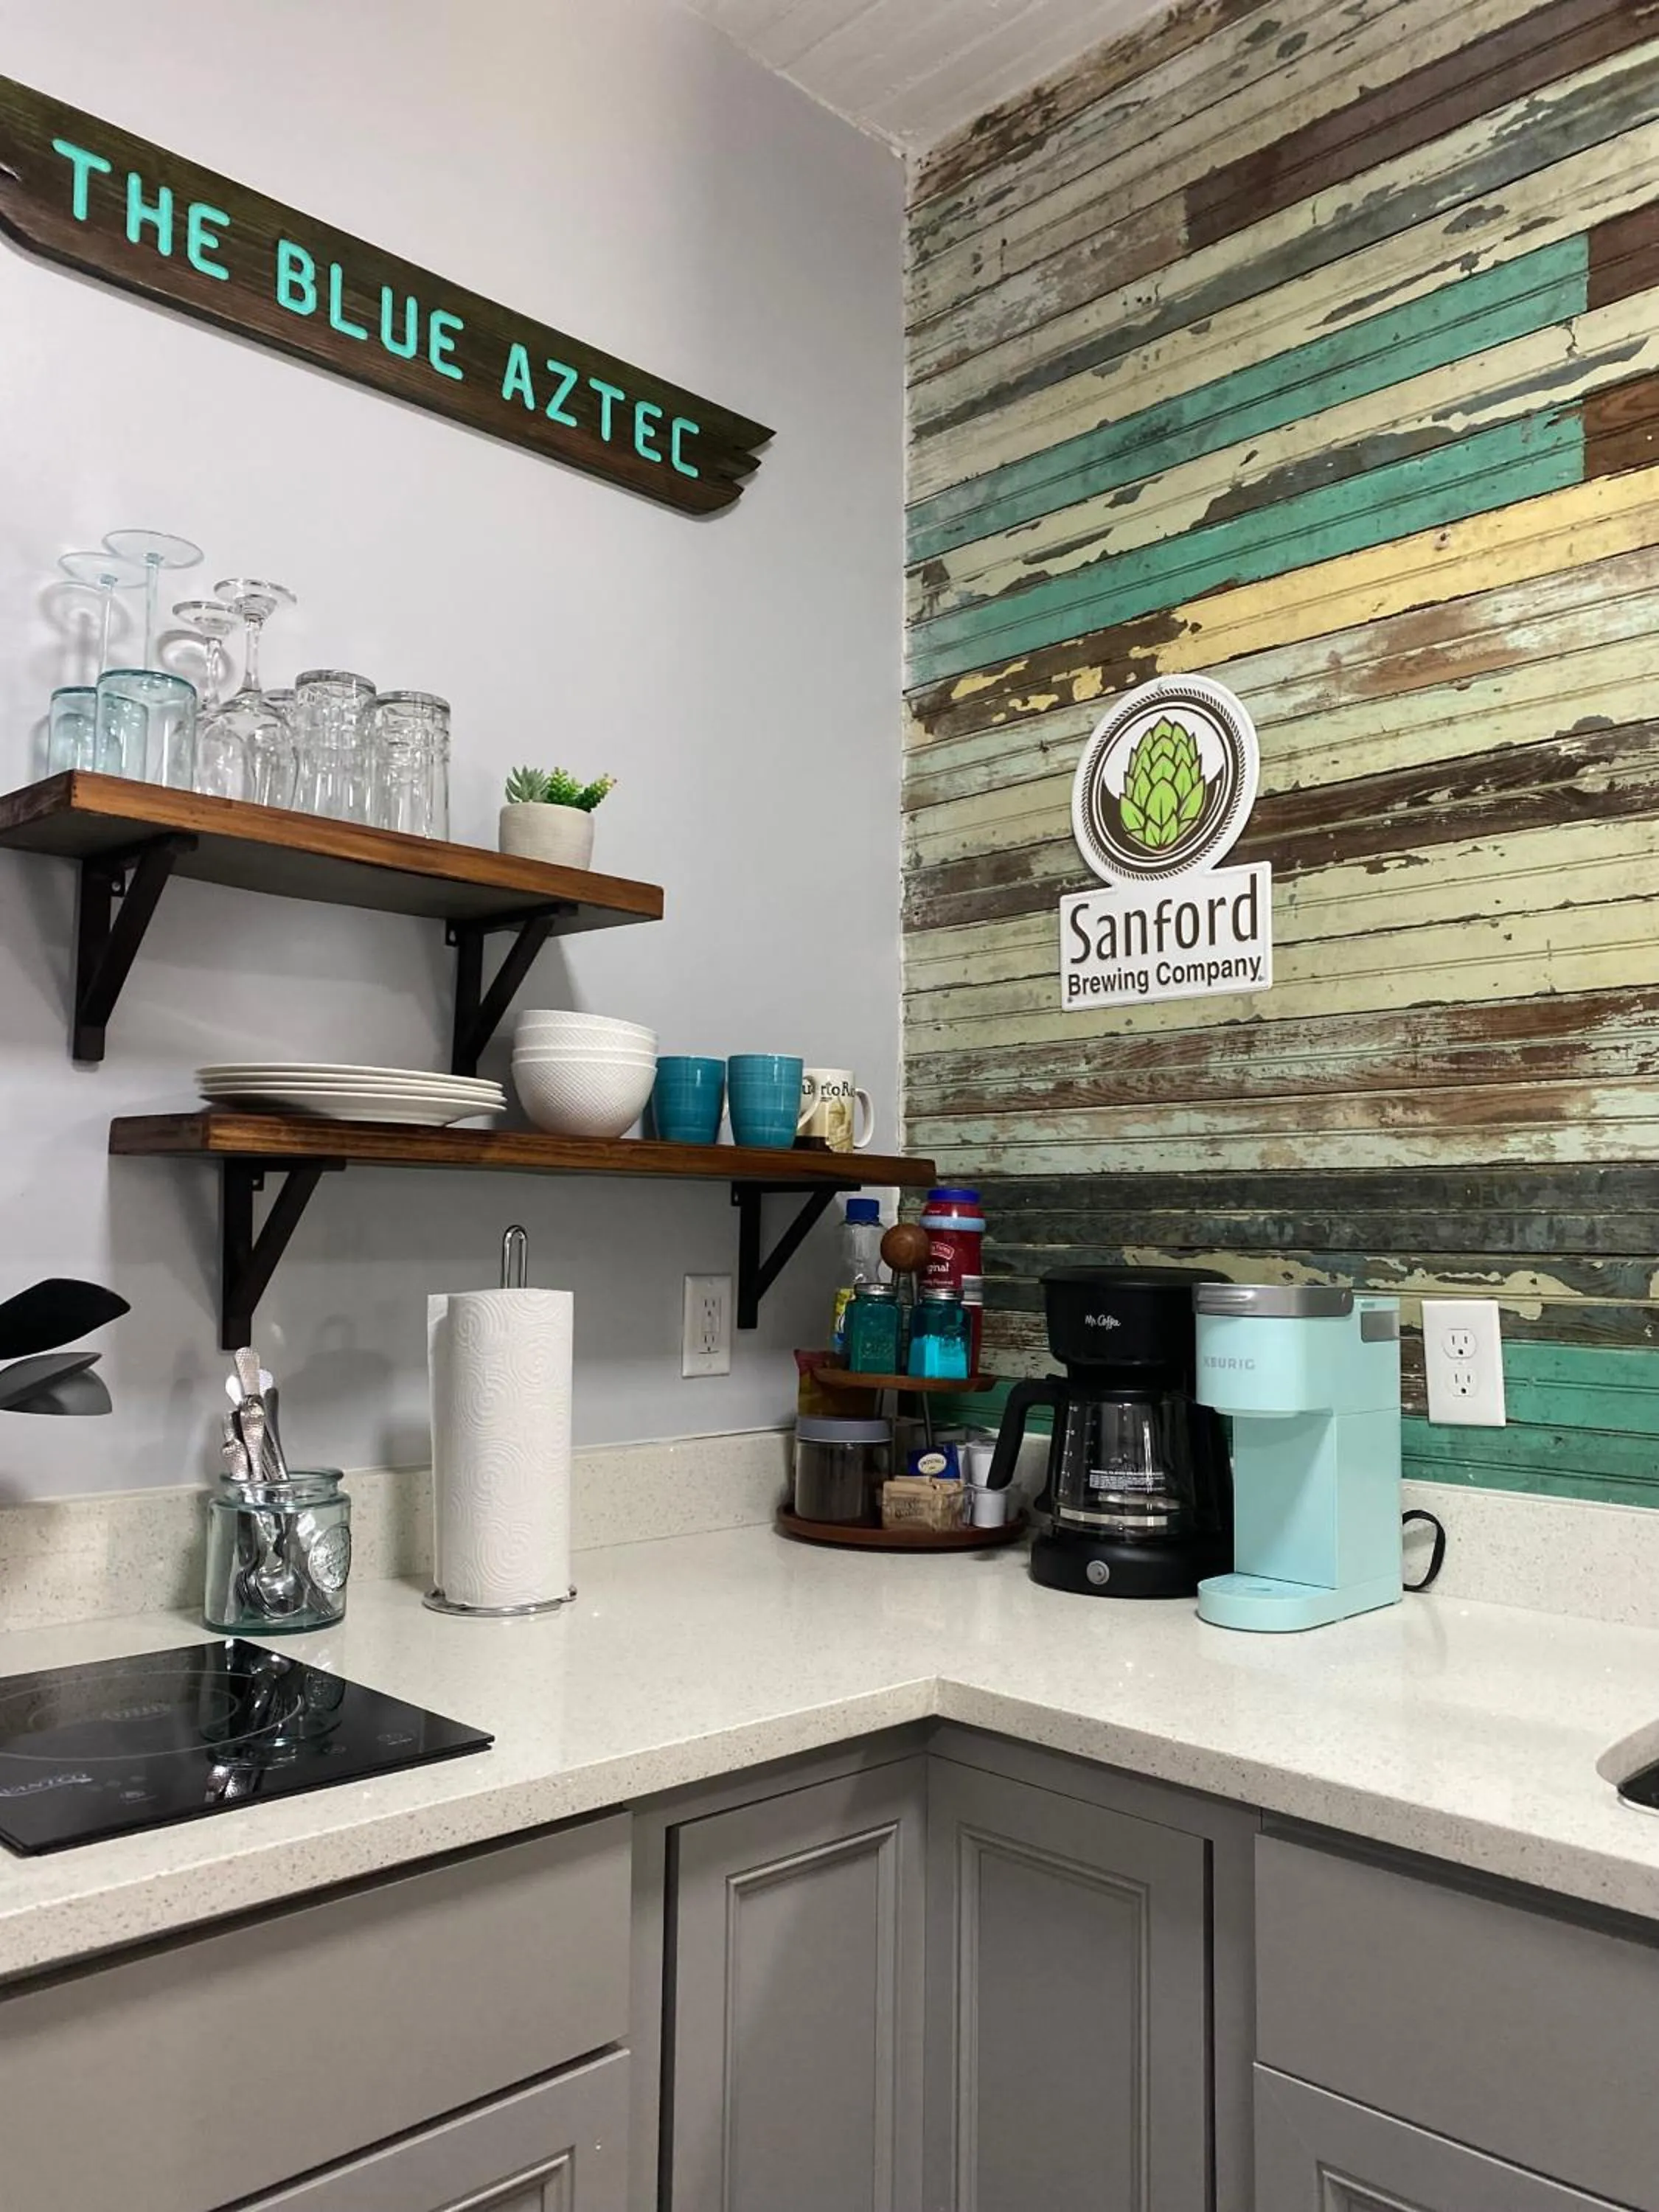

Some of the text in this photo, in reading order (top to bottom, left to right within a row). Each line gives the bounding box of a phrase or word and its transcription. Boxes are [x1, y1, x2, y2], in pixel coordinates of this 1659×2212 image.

[53, 138, 699, 478] THE BLUE AZTEC
[1068, 873, 1262, 996] Sanford Brewing Company
[927, 1262, 950, 1275] ginal
[1203, 1357, 1256, 1370] KEURIG
